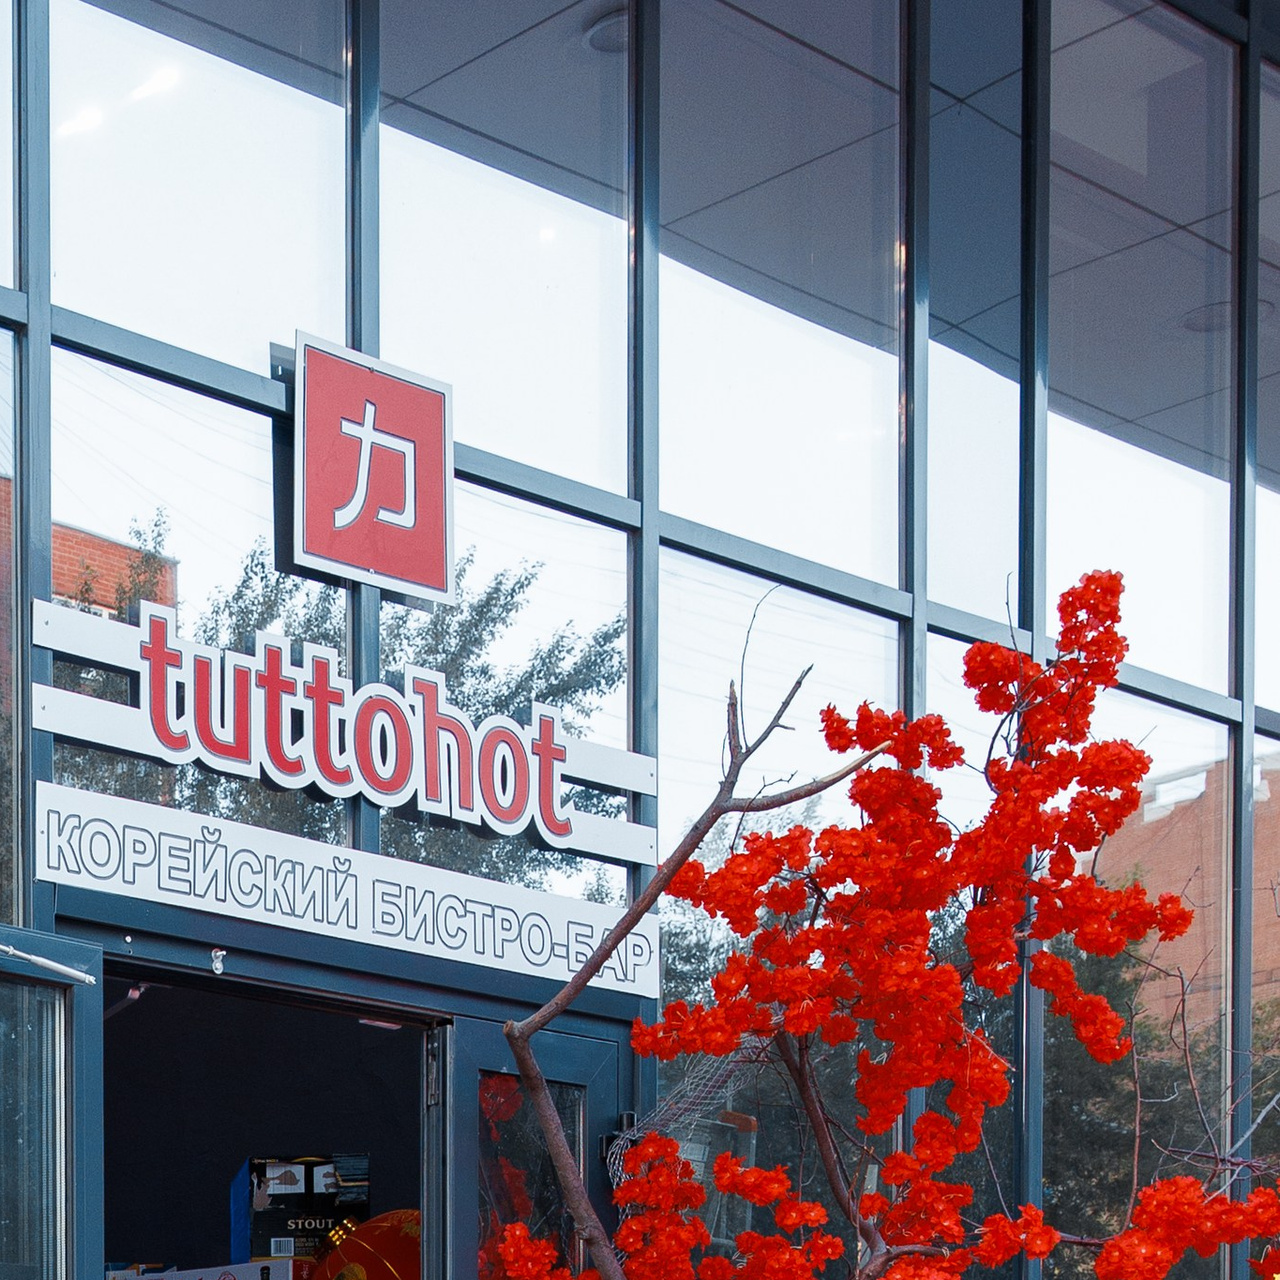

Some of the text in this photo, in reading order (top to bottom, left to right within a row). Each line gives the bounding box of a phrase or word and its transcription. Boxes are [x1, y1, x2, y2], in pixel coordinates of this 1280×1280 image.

[140, 612, 574, 840] tuttohot
[45, 808, 654, 986] КОРЕЙСКИЙ БИСТРО-БАР
[287, 1218, 335, 1230] STOUT
